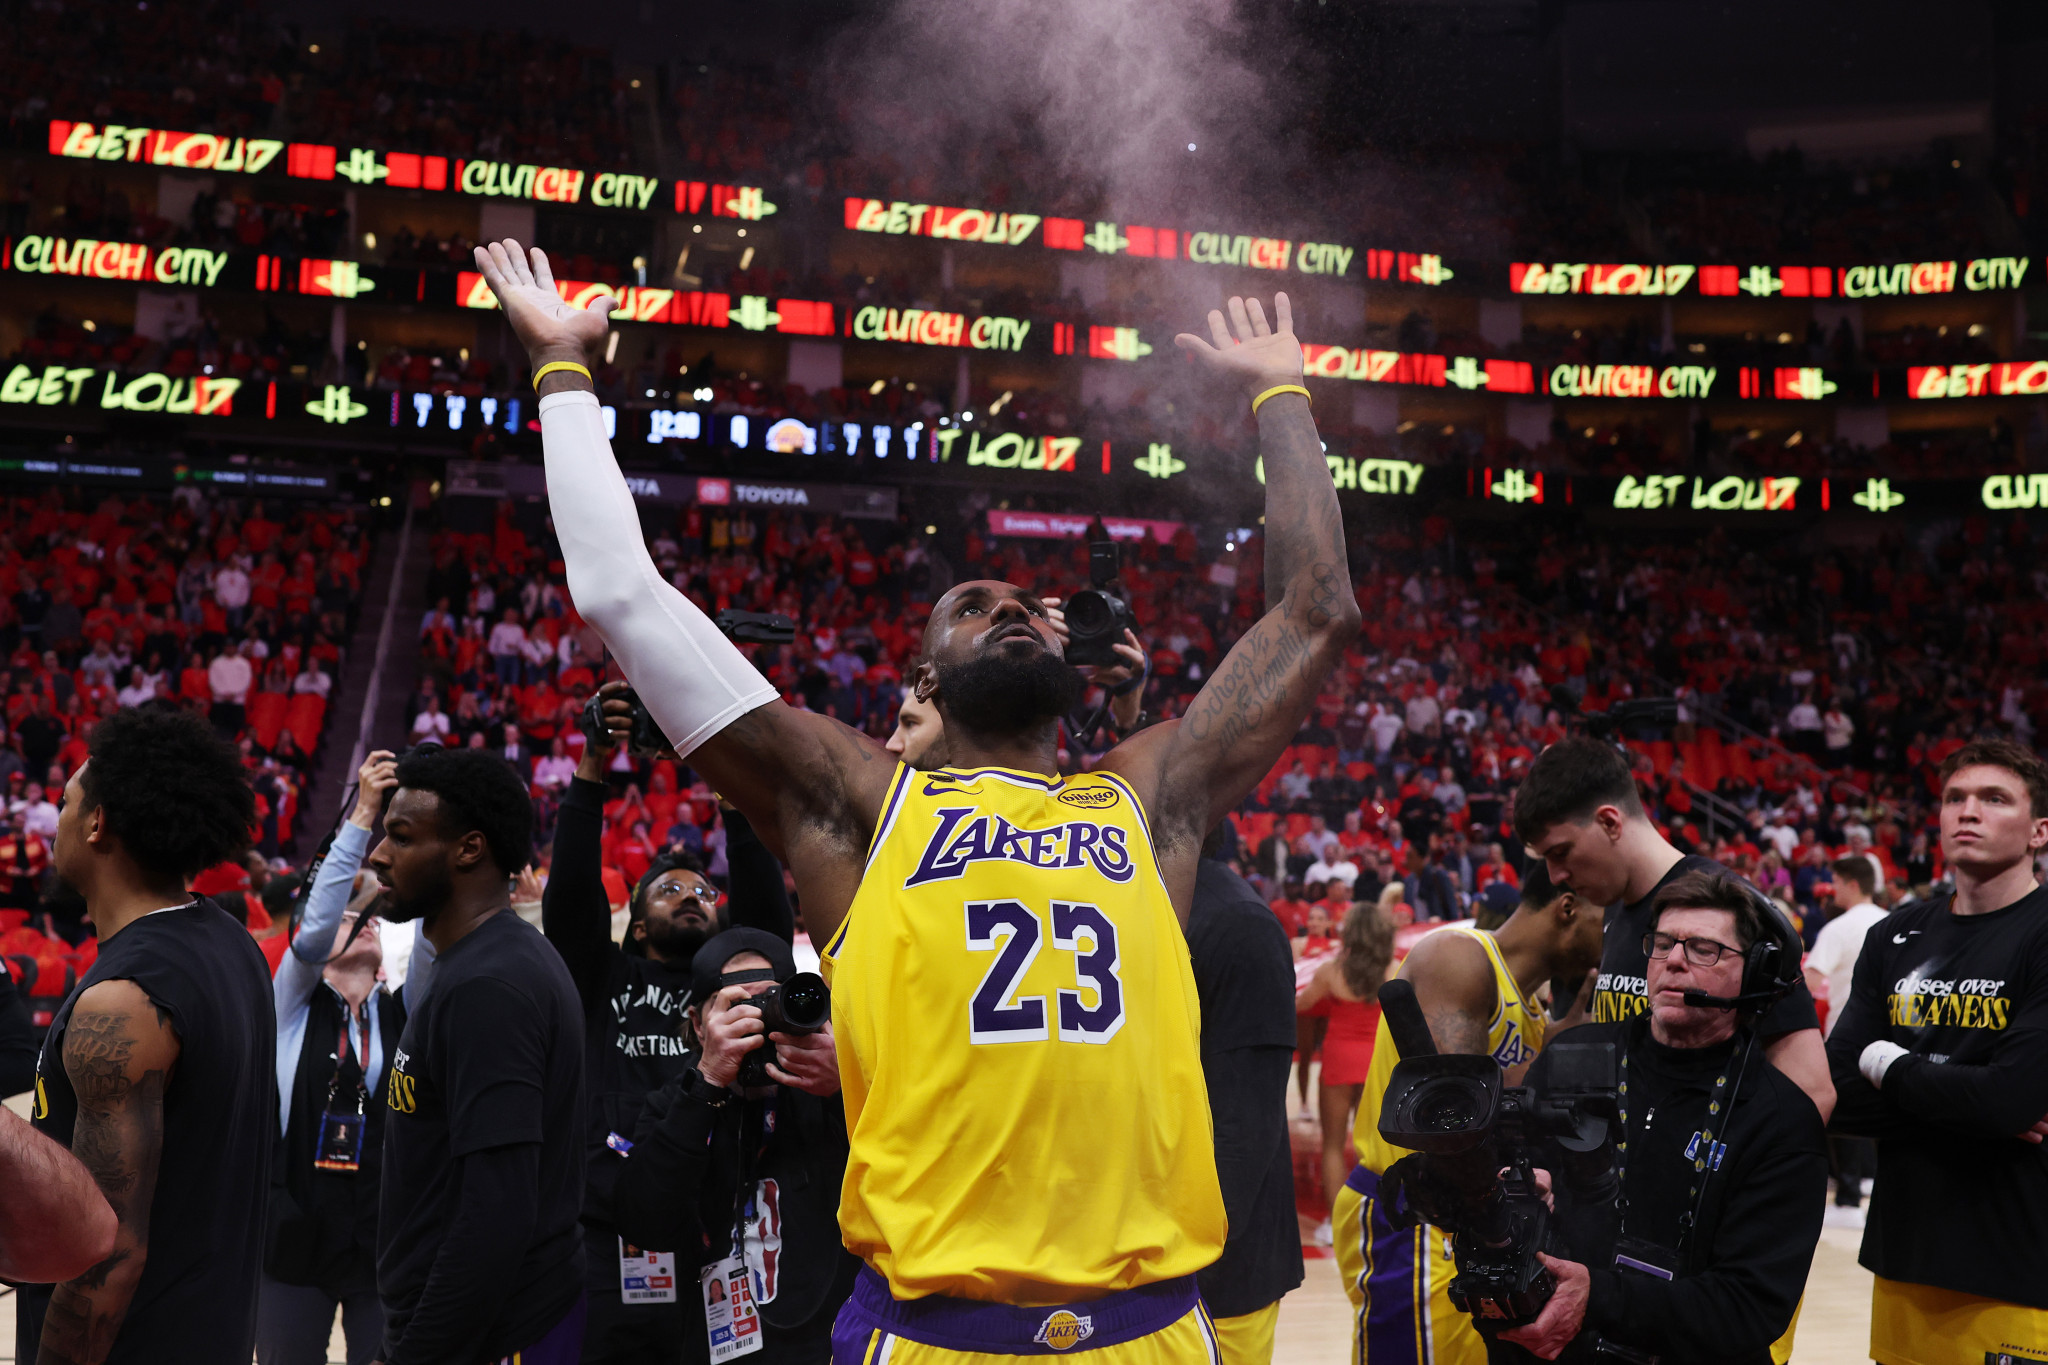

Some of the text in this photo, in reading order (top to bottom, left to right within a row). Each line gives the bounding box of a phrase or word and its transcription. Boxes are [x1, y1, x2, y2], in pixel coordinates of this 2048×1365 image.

[62, 122, 284, 174] GET LOUD
[461, 160, 657, 209] CLUTCH CITY
[856, 200, 1041, 246] GET LOUD
[13, 235, 228, 287] CLUTCH CITY
[1188, 231, 1354, 277] CLUTCH CITY
[1520, 263, 1695, 296] GET LOUD
[1843, 257, 2029, 298] CLUTCH CITY
[853, 306, 1031, 352] CLUTCH CITY
[0, 364, 241, 415] GET LOUD
[1550, 364, 1717, 398] CLUTCH CITY
[1916, 364, 1991, 399] GET
[967, 431, 1082, 471] LOUD
[734, 484, 809, 506] TOYOTA
[1358, 458, 1424, 494] CITY
[1613, 474, 1801, 510] GET LOUD
[1061, 791, 1115, 803] bibigo
[902, 805, 1137, 891] LAKERS
[963, 897, 1127, 1045] 23
[1958, 978, 2005, 997] over
[1034, 1321, 1093, 1342] LAKERS
